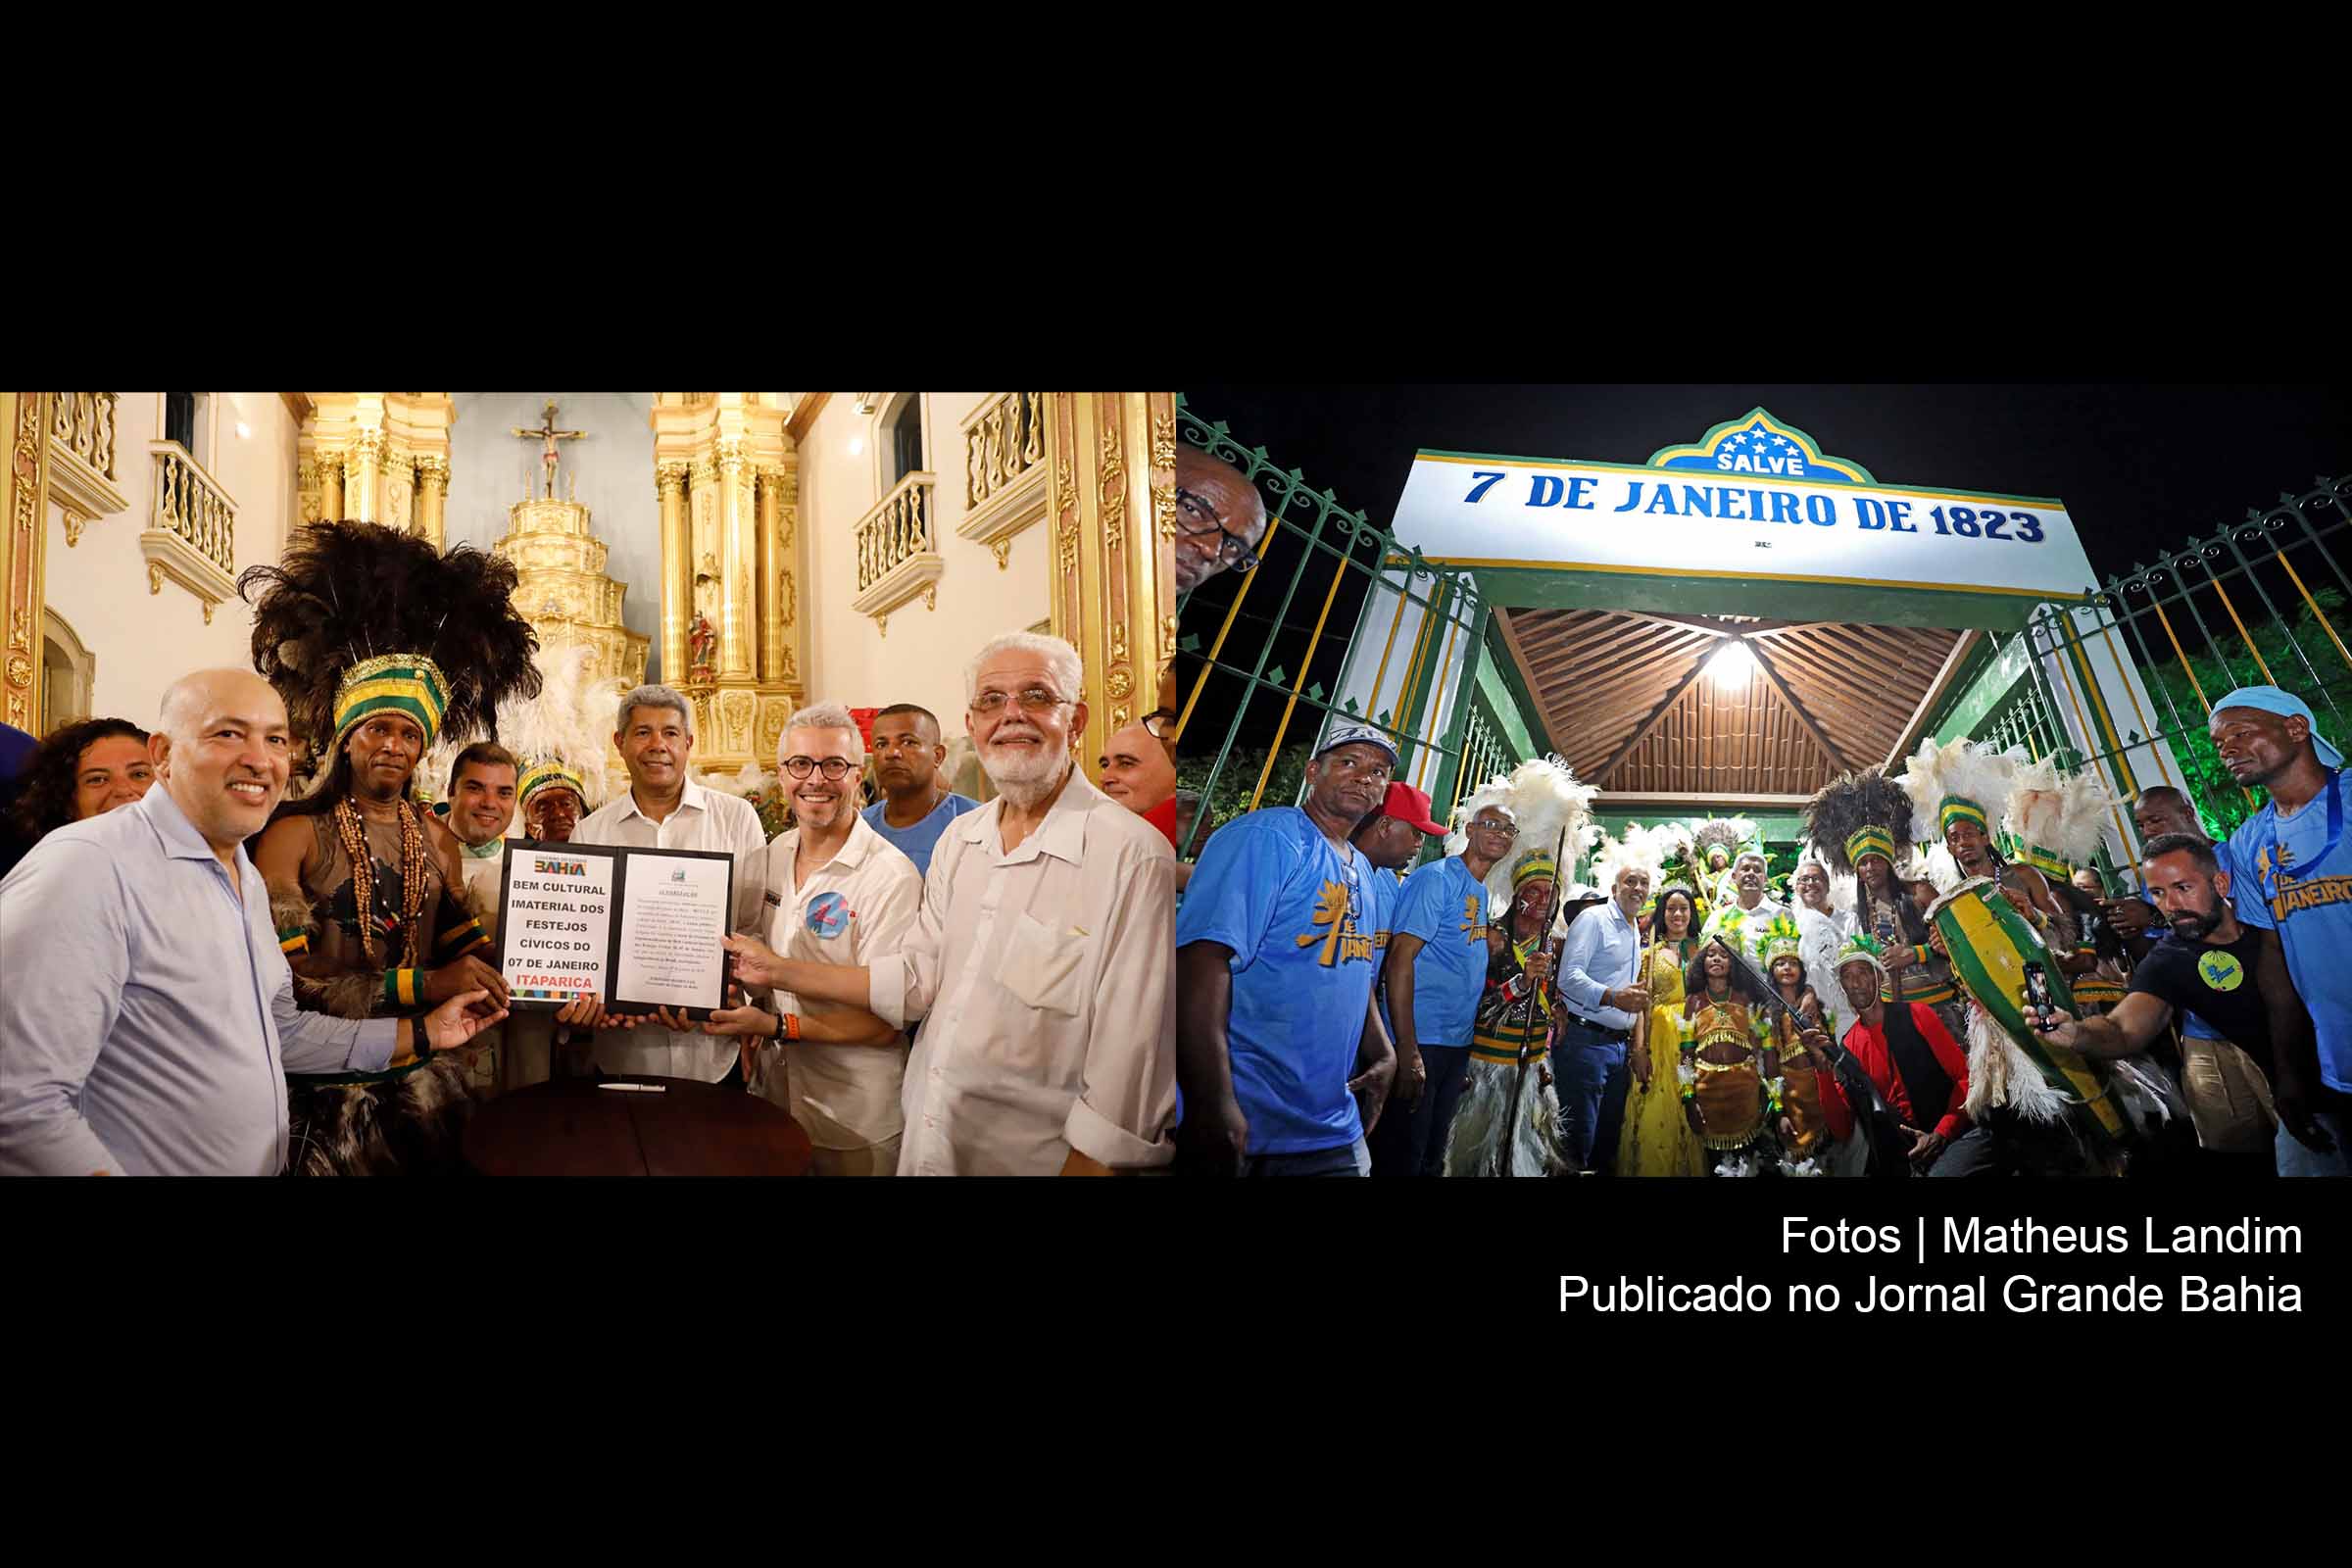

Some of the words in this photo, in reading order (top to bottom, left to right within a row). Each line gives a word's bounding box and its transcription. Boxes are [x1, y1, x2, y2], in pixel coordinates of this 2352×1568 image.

[1717, 453, 1804, 475] SALVE
[1464, 471, 1507, 503] 7
[1525, 475, 1598, 511] DE
[1614, 481, 1837, 527] JANEIRO
[1853, 497, 1918, 533] DE
[1930, 505, 2046, 543] 1823
[535, 860, 587, 876] BAHIA
[513, 880, 539, 890] BEM
[543, 882, 606, 895] CULTURAL
[512, 900, 576, 912] IMATERIAL
[580, 905, 605, 914] DOS
[526, 919, 587, 932] FESTEJOS
[519, 938, 570, 951] CÍVICOS
[573, 942, 591, 952] DO
[508, 957, 522, 967] 07
[527, 958, 542, 968] DE
[546, 959, 599, 971] JANEIRO
[516, 974, 593, 989] ITAPARICA
